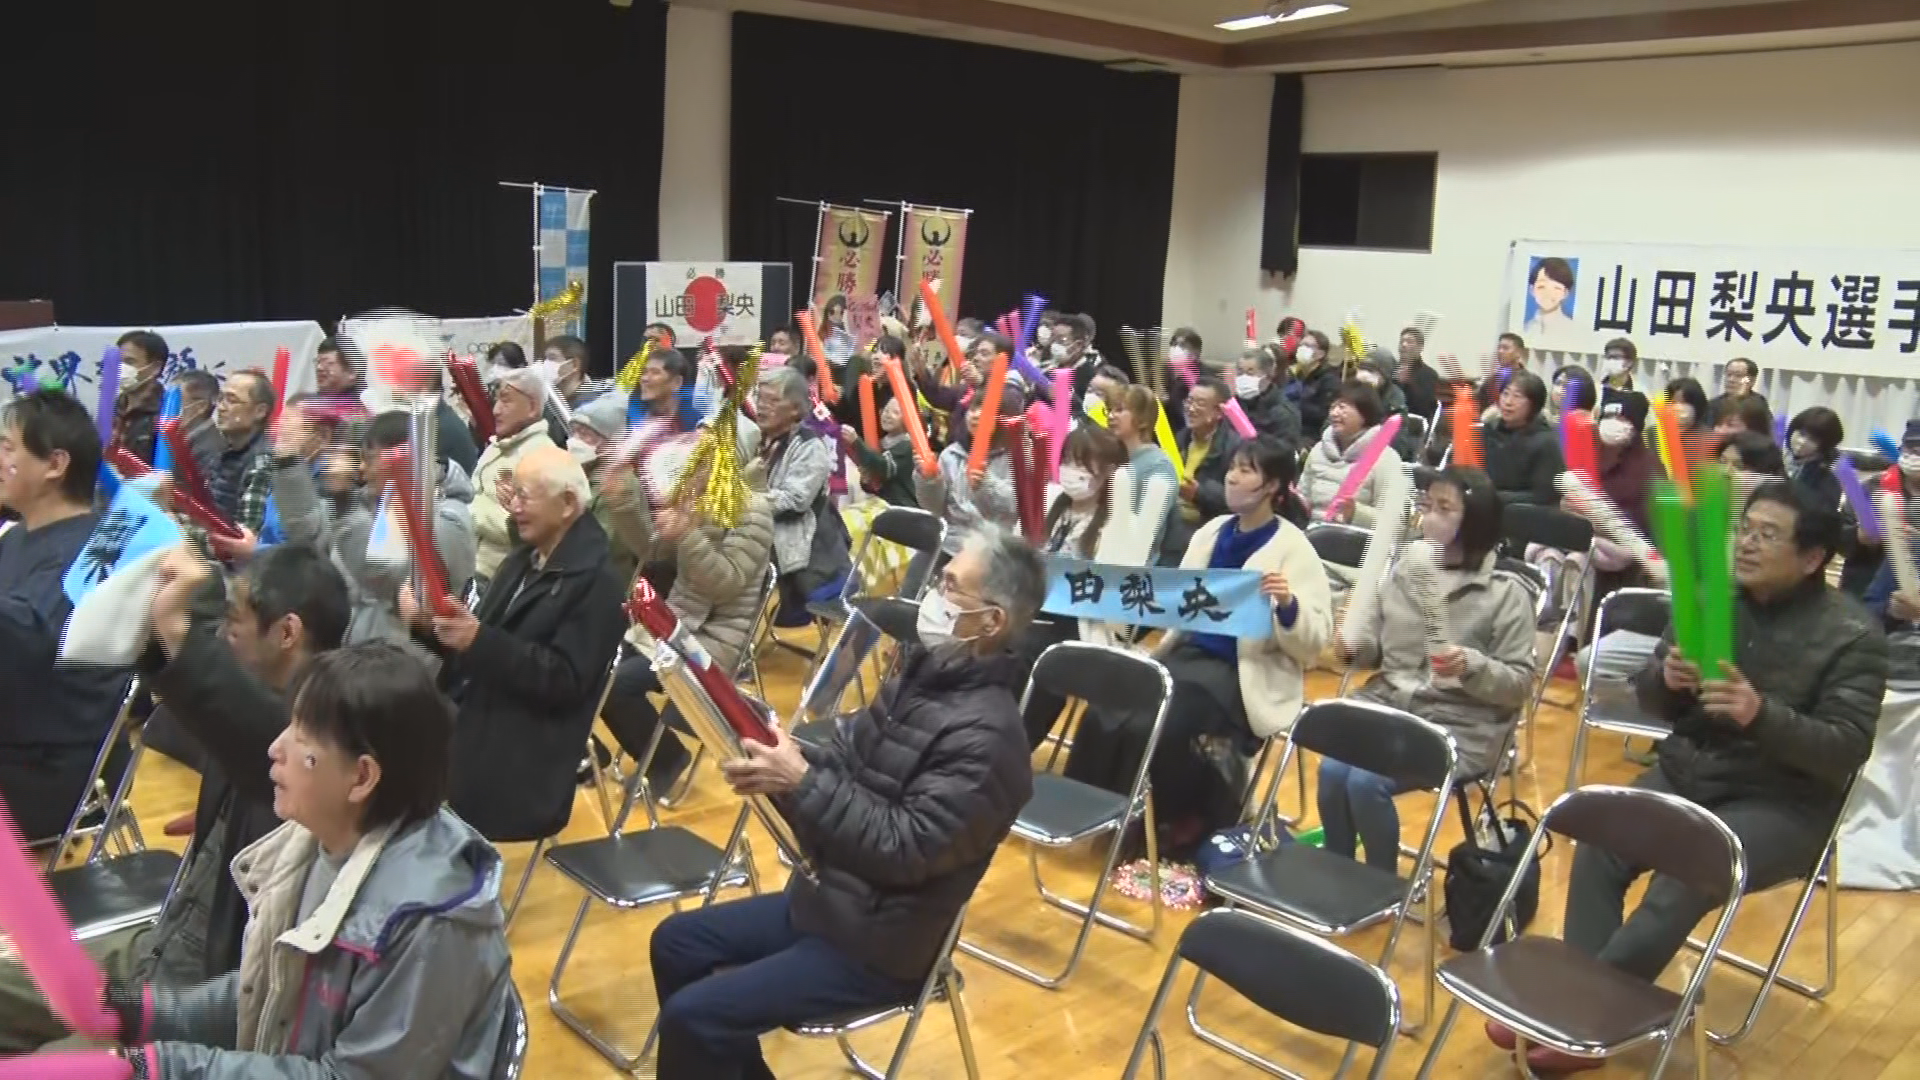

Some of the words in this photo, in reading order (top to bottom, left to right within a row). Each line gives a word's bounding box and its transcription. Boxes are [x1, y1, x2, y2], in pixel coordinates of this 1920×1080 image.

[837, 249, 861, 294] 必勝
[1593, 264, 1920, 353] 山田梨央選手
[1064, 568, 1234, 623] 田梨央
